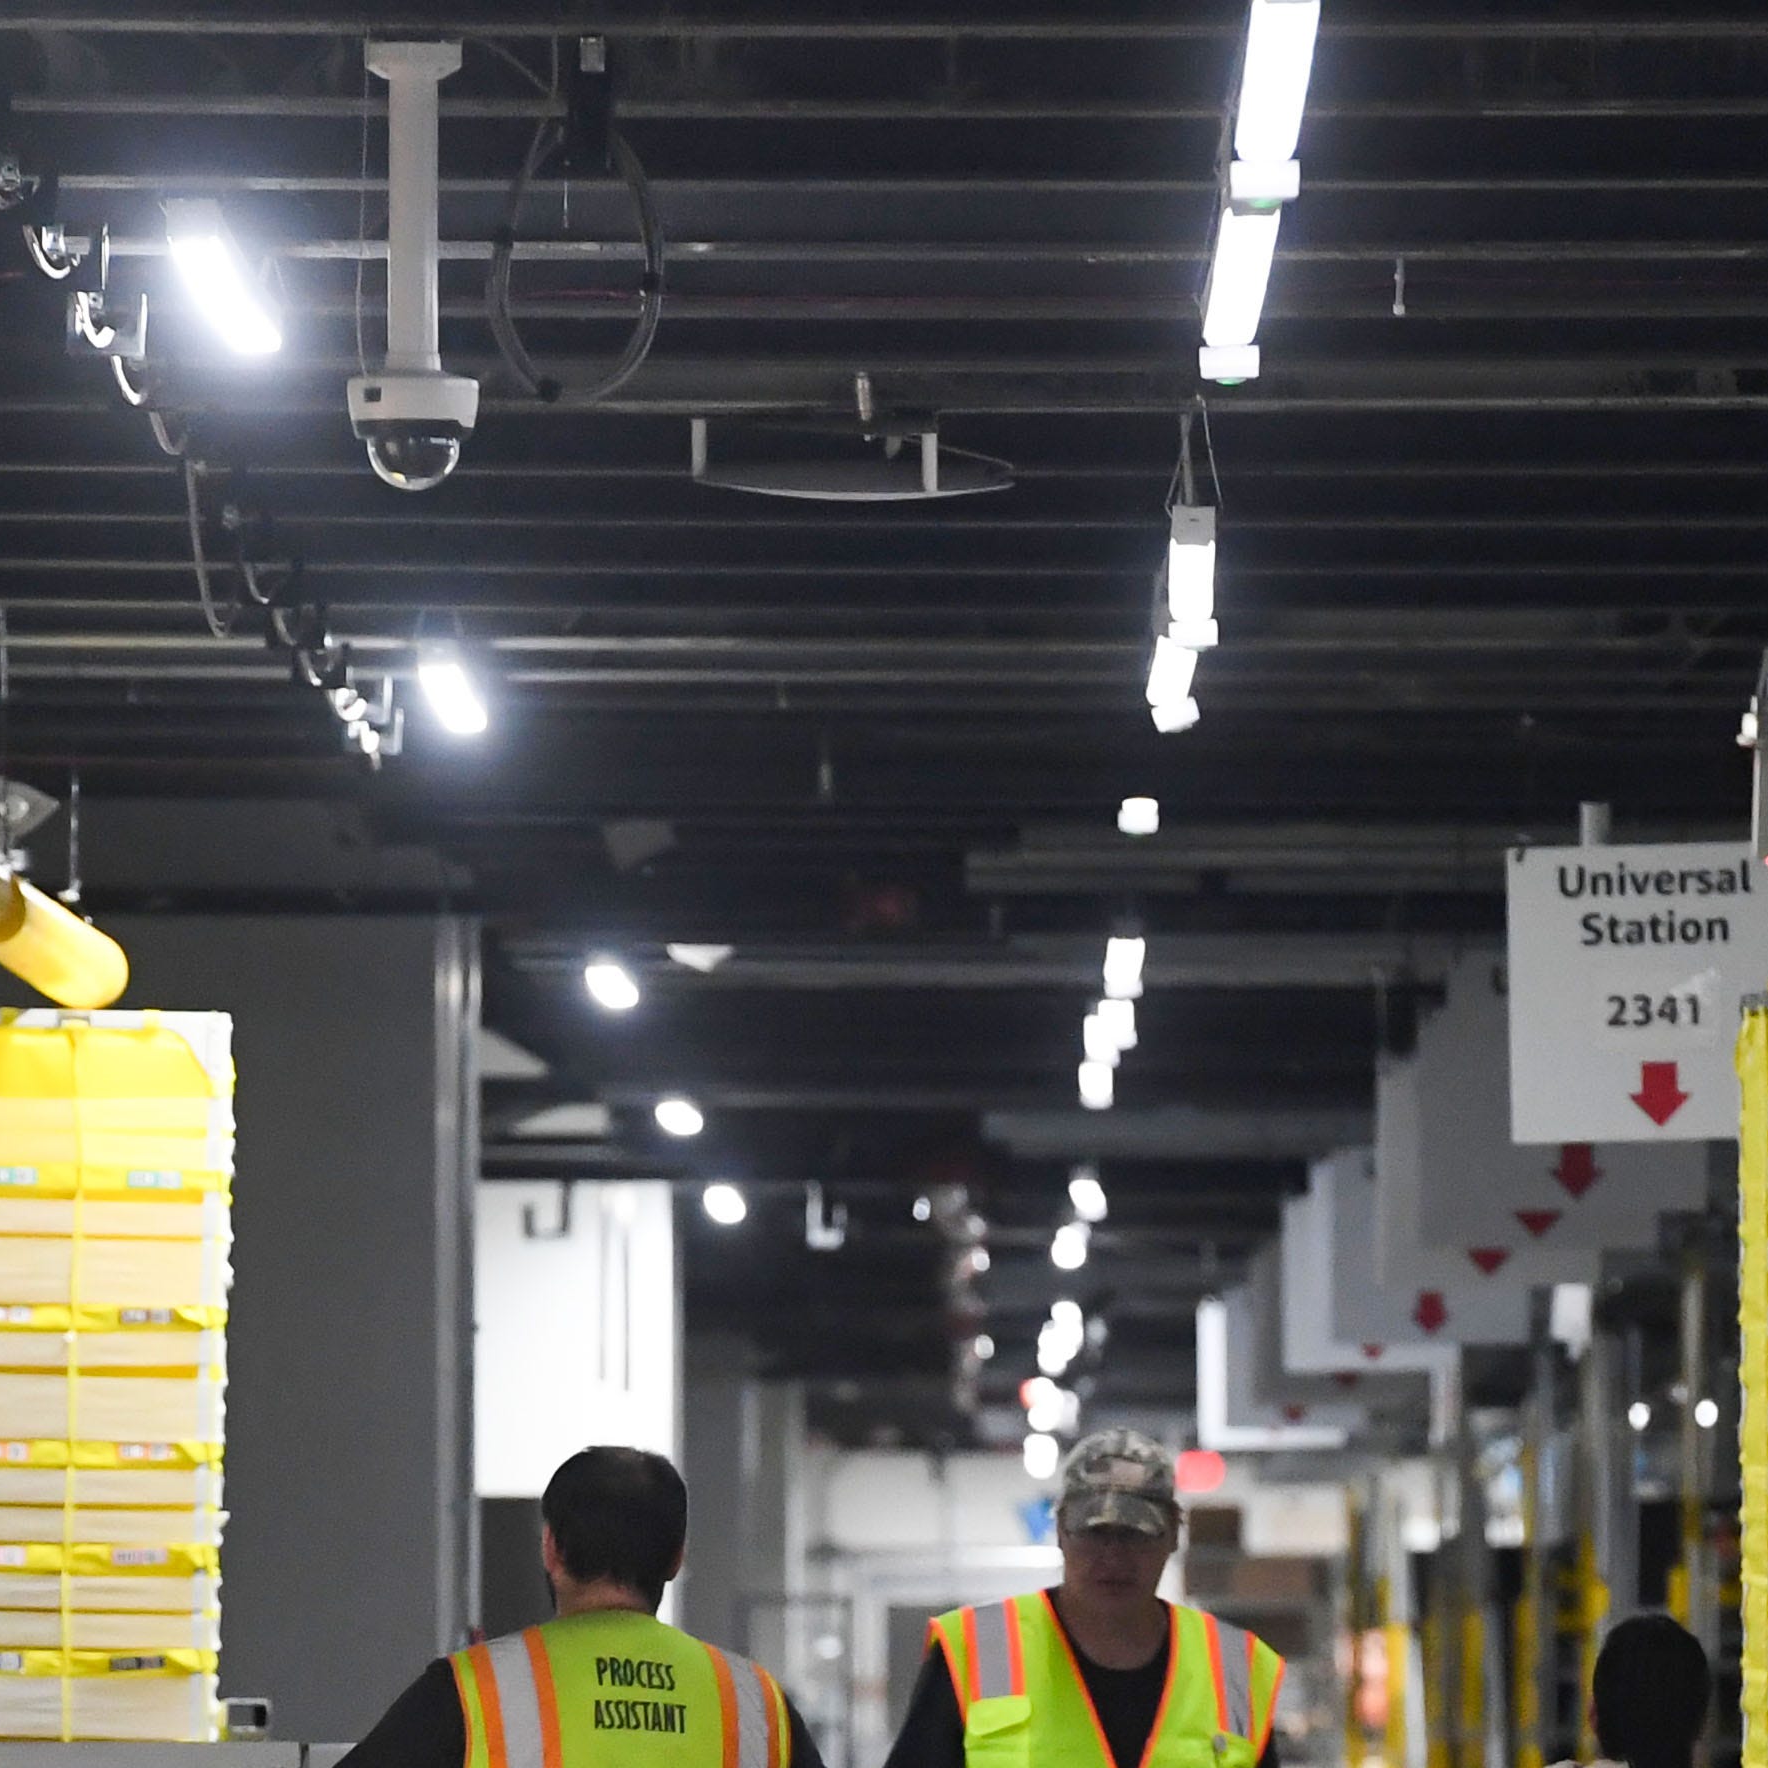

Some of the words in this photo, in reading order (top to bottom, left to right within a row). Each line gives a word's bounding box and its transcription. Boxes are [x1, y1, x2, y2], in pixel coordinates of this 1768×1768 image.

[1558, 858, 1752, 898] Universal
[1581, 909, 1730, 946] Station
[1607, 993, 1701, 1027] 2341
[595, 1656, 675, 1691] PROCESS
[594, 1699, 687, 1734] ASSISTANT
